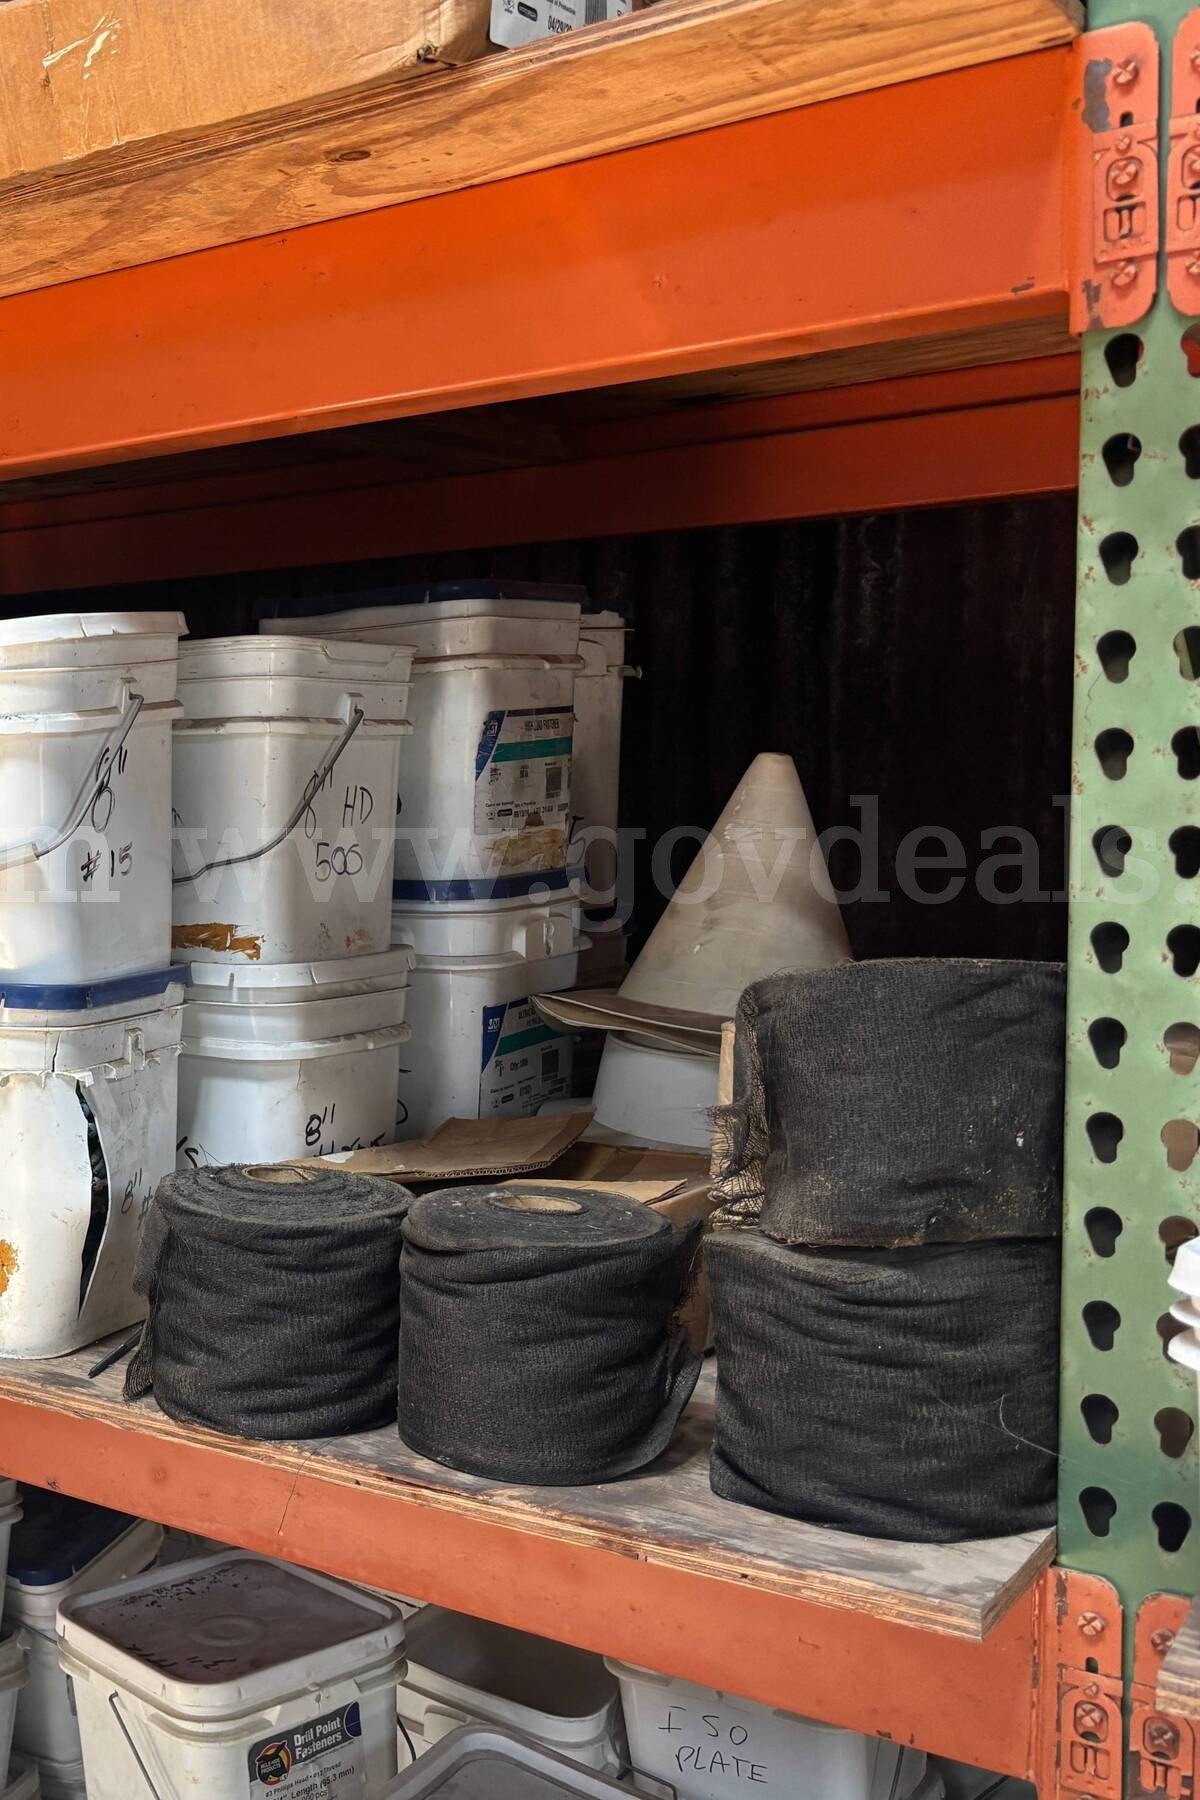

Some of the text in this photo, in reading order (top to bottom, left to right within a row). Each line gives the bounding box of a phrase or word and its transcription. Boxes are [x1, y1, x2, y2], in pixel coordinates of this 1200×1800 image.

[343, 785, 374, 828] HD
[81, 841, 133, 882] #15
[305, 1103, 336, 1146] 8"
[294, 1717, 341, 1747] Drill Point
[295, 1732, 342, 1760] Fasteners
[273, 1784, 293, 1795] Phillips
[294, 1776, 309, 1786] Head
[323, 1763, 341, 1773] Thread
[675, 1745, 768, 1783] PLATE
[291, 1766, 355, 1799] Length (95.3 mm)
